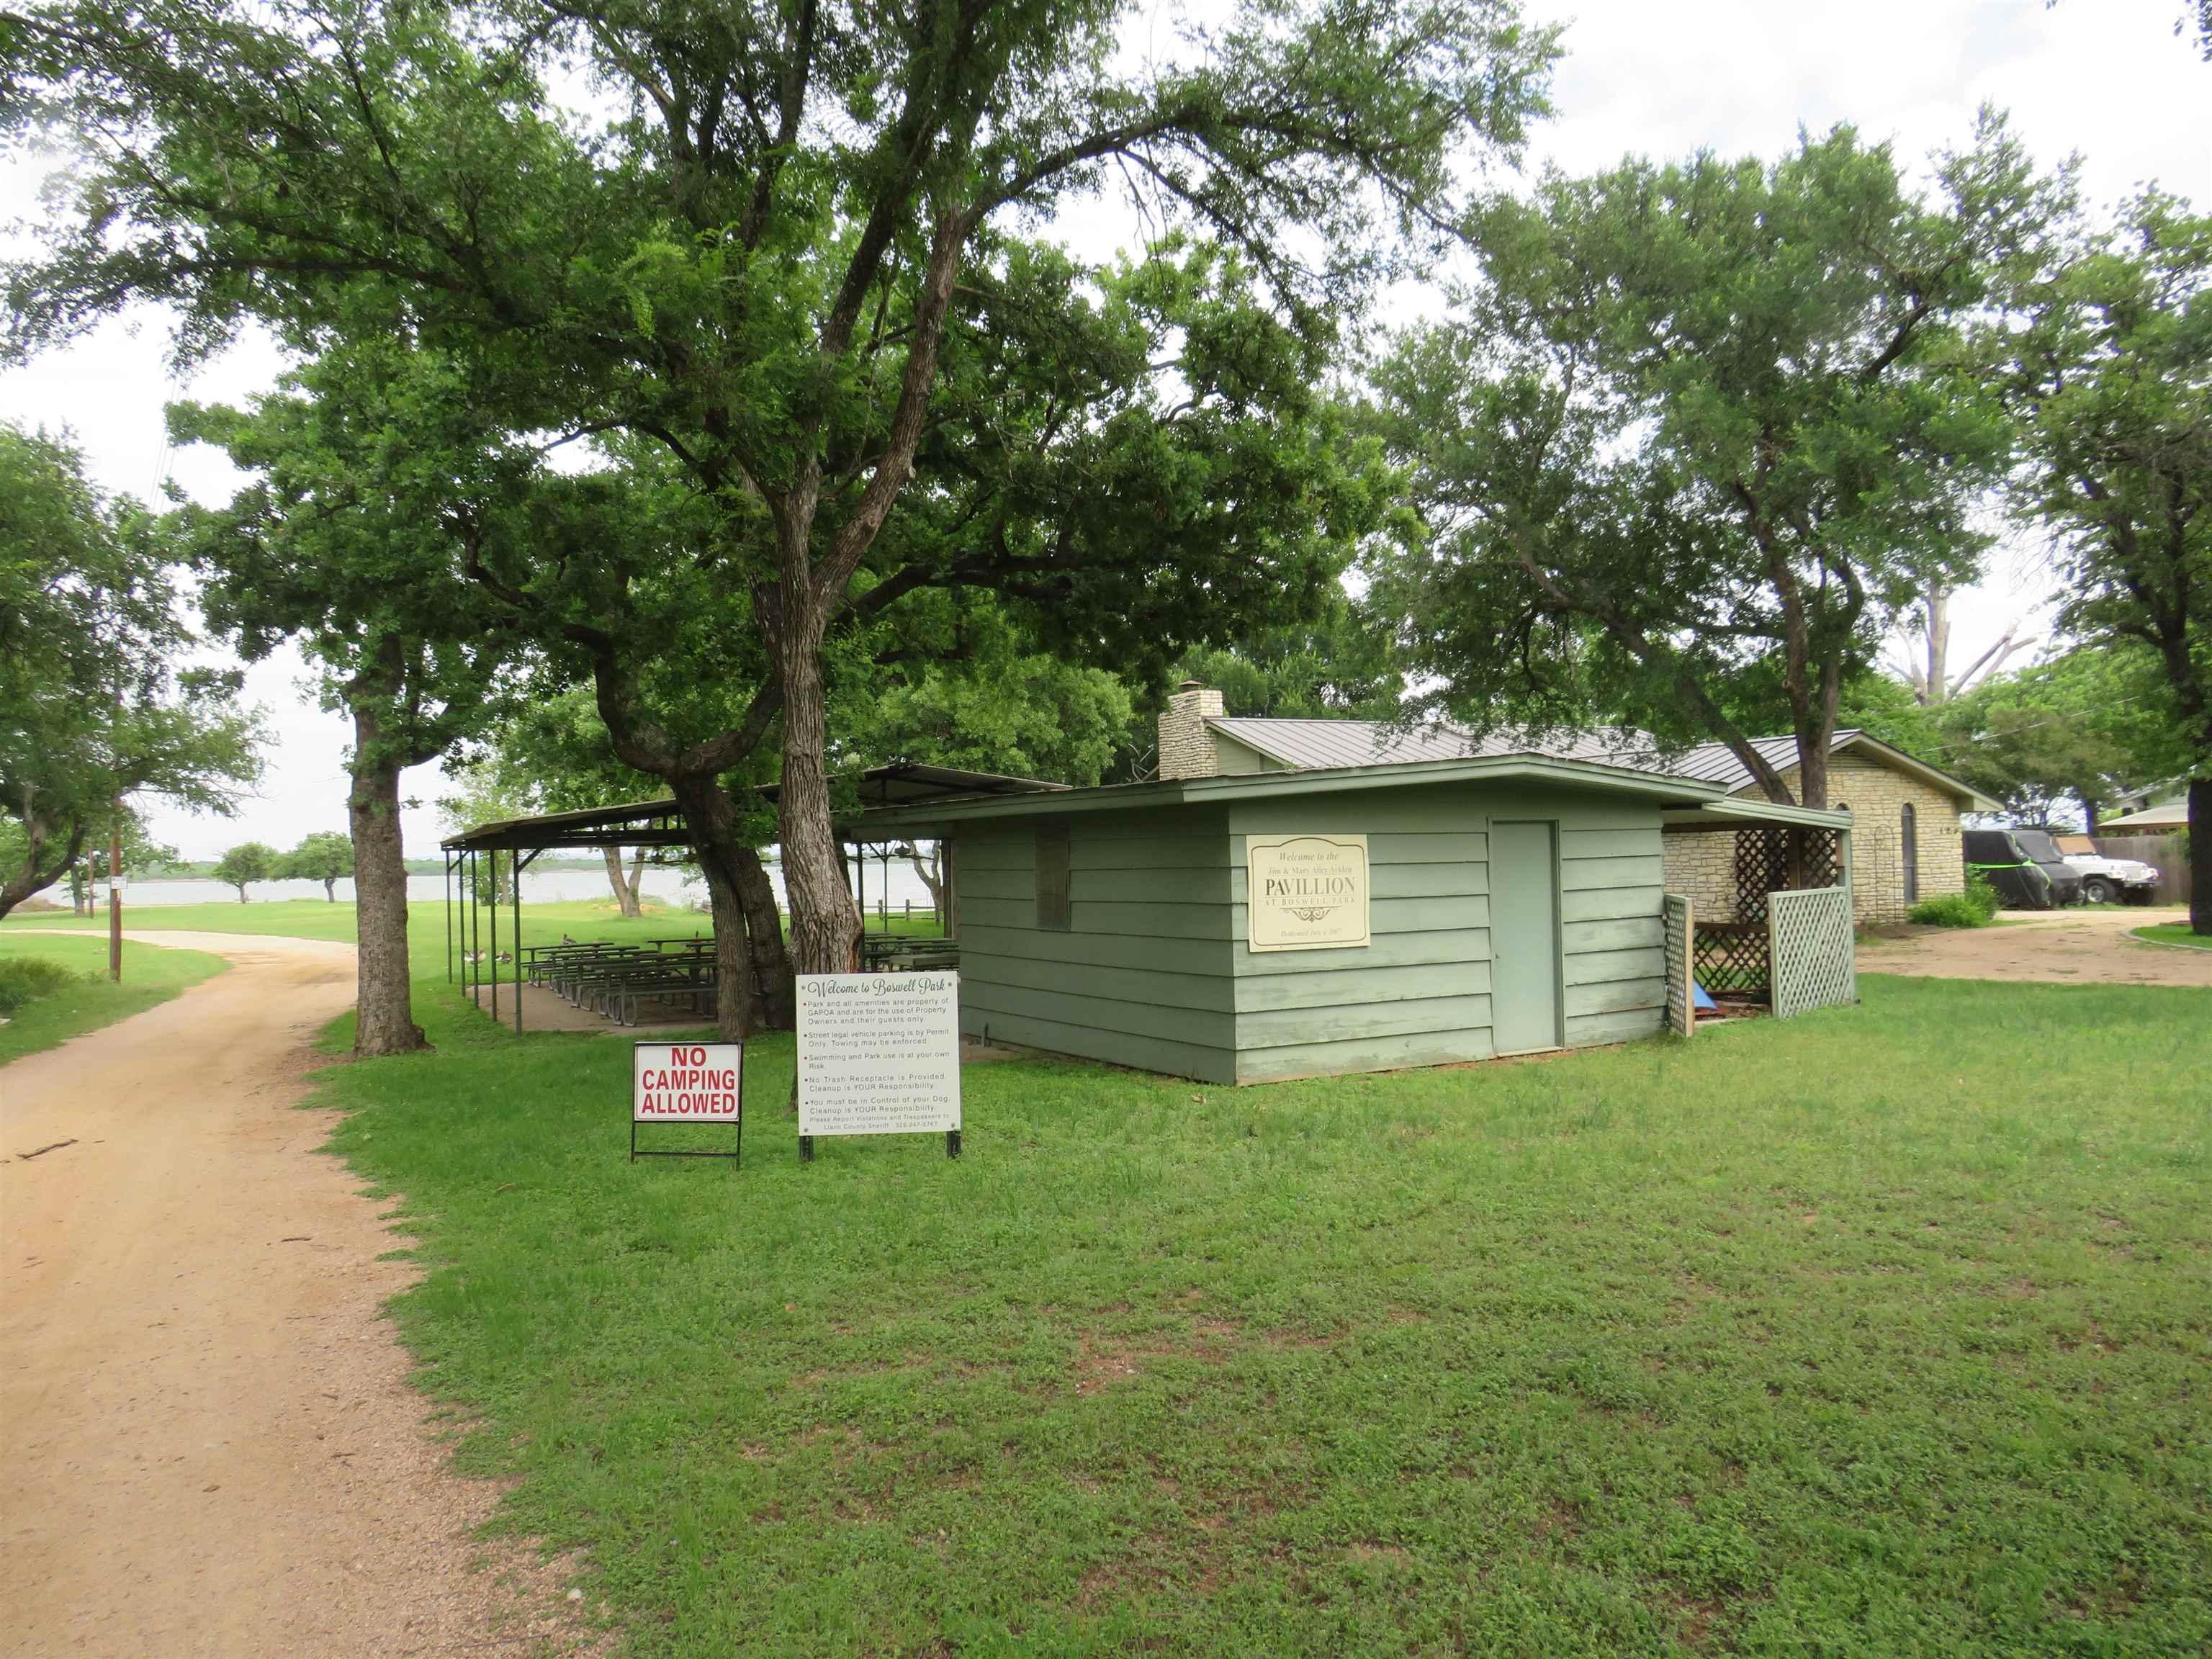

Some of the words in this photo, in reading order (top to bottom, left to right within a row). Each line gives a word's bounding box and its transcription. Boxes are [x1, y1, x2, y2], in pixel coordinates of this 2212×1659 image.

[1280, 852, 1315, 860] Welcome
[1266, 876, 1355, 896] PAVILLION
[807, 980, 858, 997] Welcome
[861, 982, 869, 992] to
[873, 979, 916, 996] Boswell
[919, 978, 945, 994] Park
[672, 1048, 706, 1066] NO
[643, 1070, 735, 1089] CAMPING
[642, 1093, 735, 1113] ALLOWED
